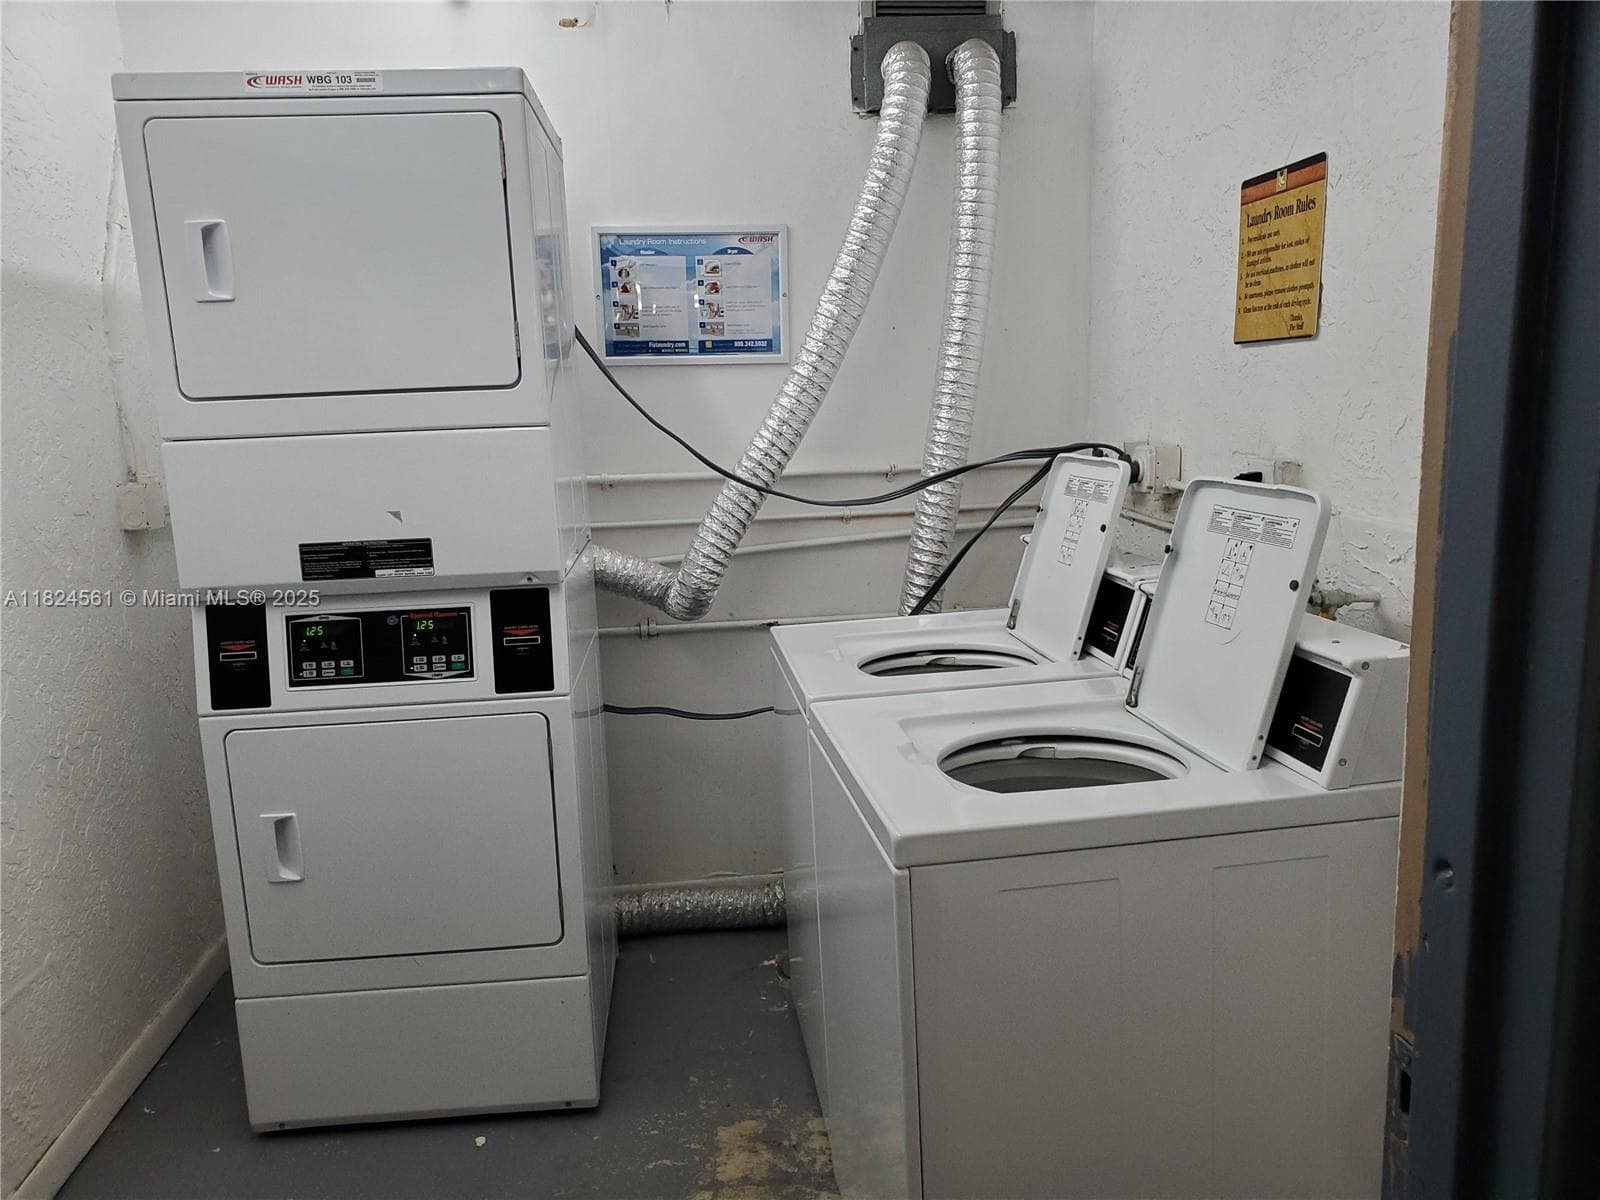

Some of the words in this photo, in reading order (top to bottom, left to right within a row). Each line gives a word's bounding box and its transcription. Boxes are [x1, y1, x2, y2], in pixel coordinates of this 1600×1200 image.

[265, 75, 303, 85] WASH
[306, 75, 332, 84] WBG
[335, 75, 353, 84] 103
[1247, 208, 1271, 227] Laundry
[1274, 203, 1294, 220] Room
[1296, 194, 1316, 214] Rules
